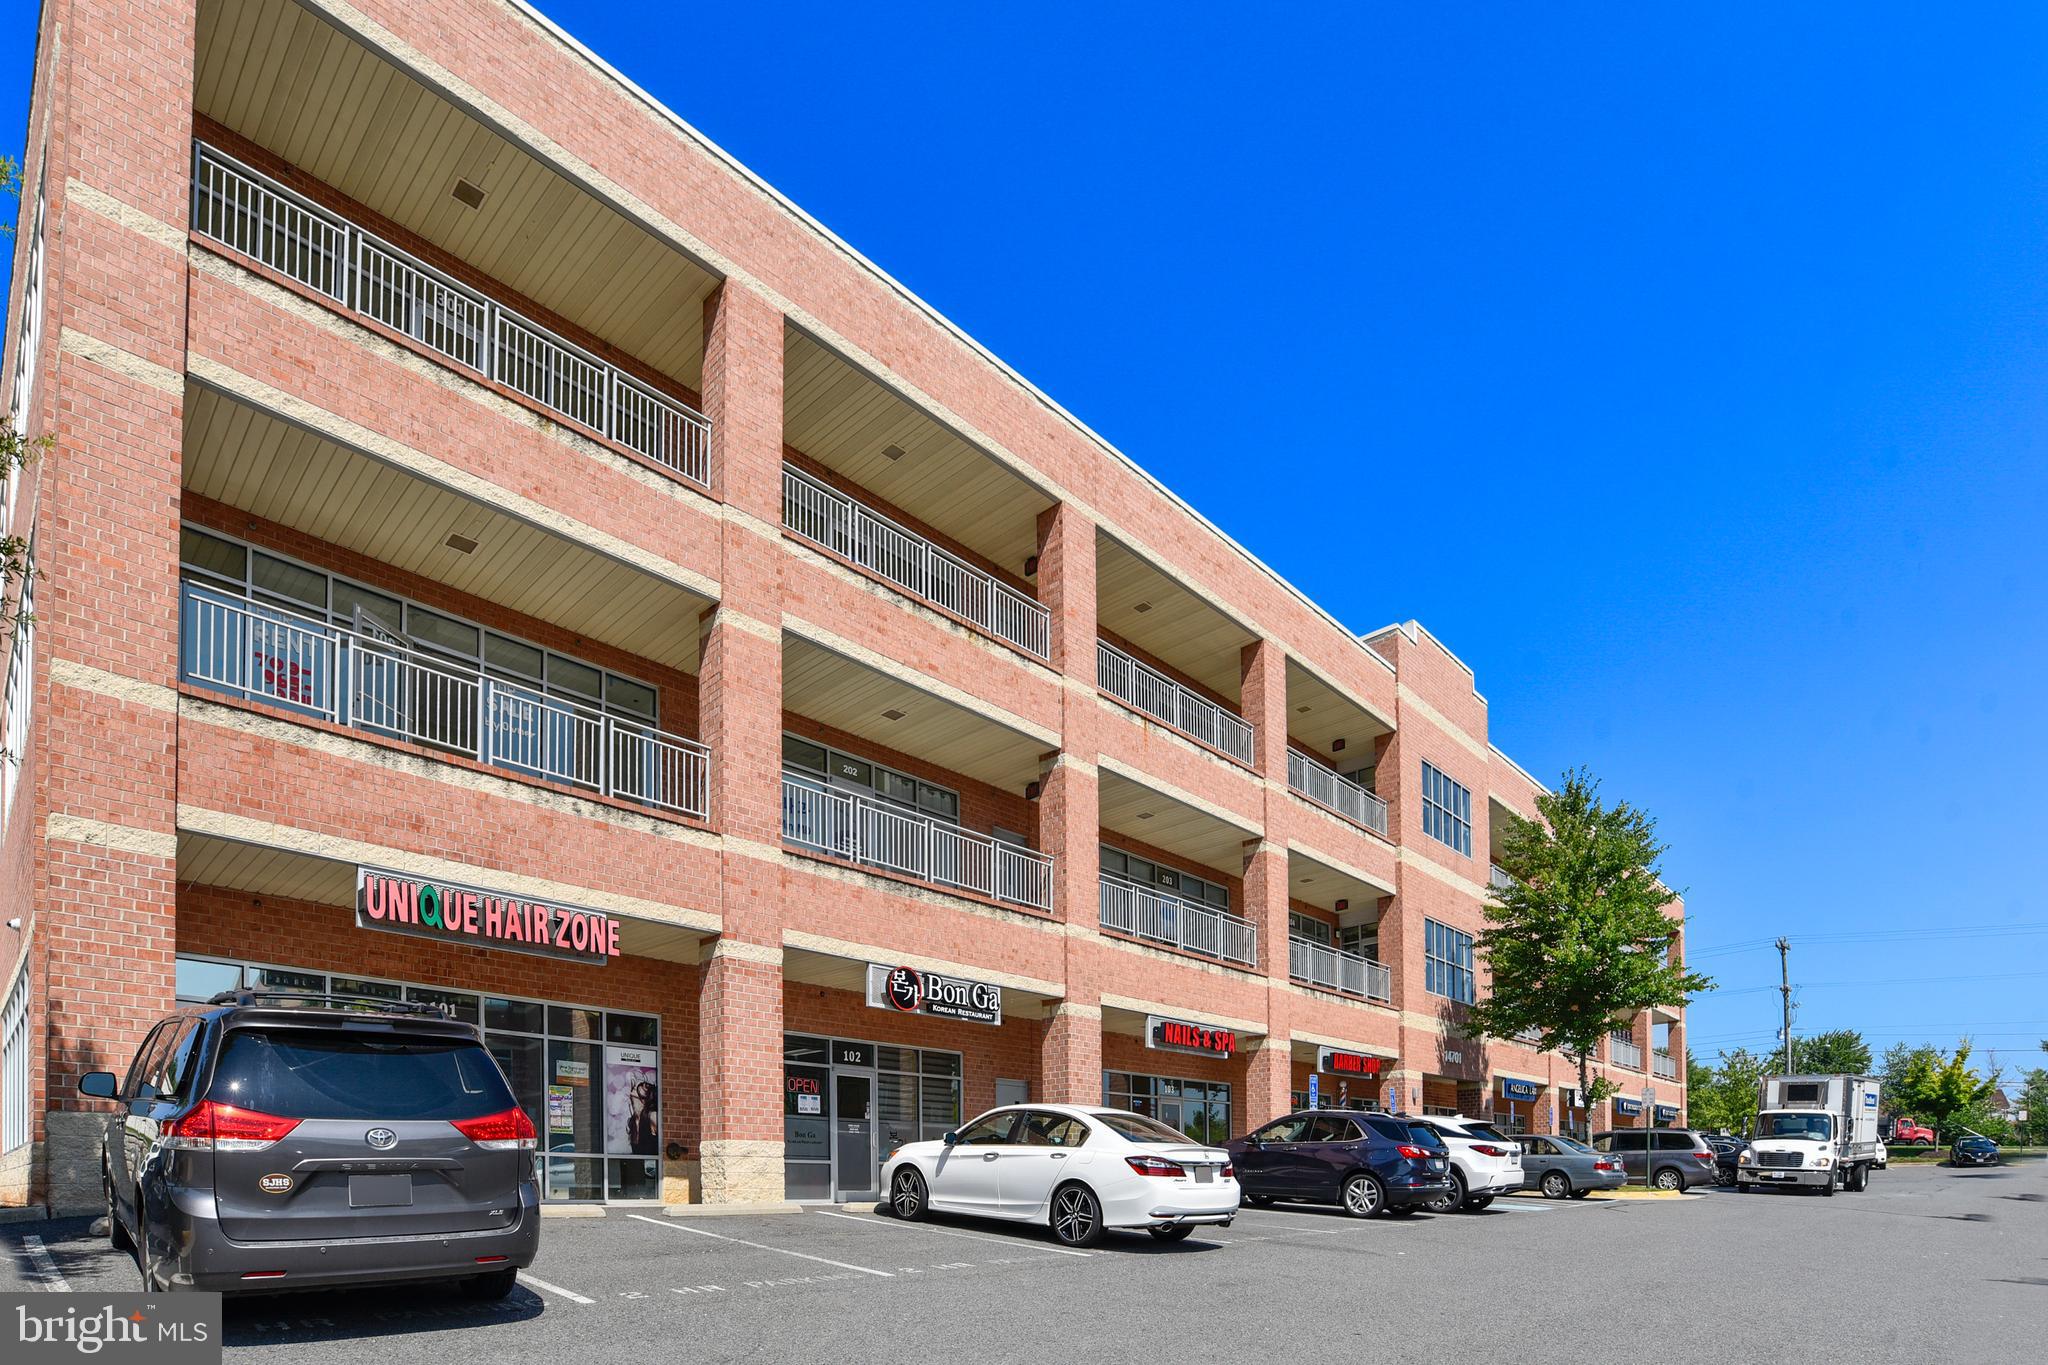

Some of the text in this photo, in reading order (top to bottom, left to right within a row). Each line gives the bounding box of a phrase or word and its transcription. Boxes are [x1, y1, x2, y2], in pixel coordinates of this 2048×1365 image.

[437, 292, 464, 318] 301
[254, 624, 317, 657] RENT
[843, 764, 859, 777] 202
[1162, 874, 1173, 886] 203
[366, 874, 621, 957] UNIQUE HAIR ZONE
[891, 969, 921, 1007] 본가
[927, 973, 1000, 1011] Bon Ga
[932, 1004, 994, 1021] KOREAN RESTAURANT
[1165, 1022, 1236, 1053] NAILS & SPA
[621, 1051, 641, 1059] UNIQUE
[843, 1050, 861, 1063] 102
[1333, 1052, 1380, 1074] BARBER SHOP
[787, 1077, 820, 1094] OPEN
[1164, 1084, 1175, 1094] 103
[262, 1178, 290, 1187] SJHS
[619, 1291, 650, 1299] 2
[671, 1284, 726, 1295] HR
